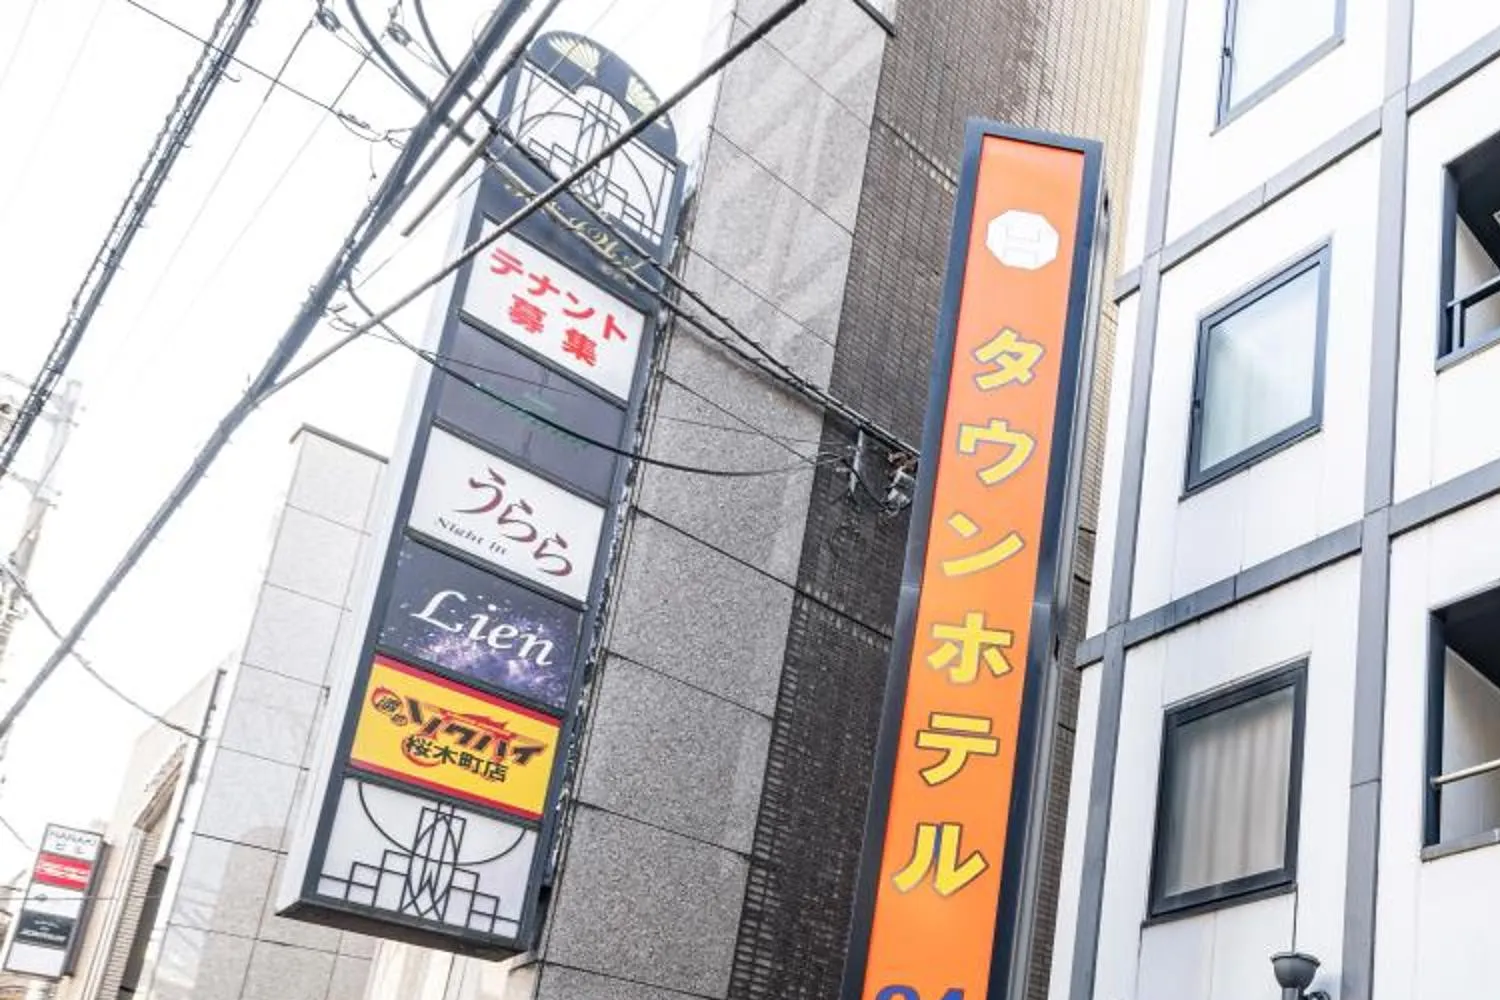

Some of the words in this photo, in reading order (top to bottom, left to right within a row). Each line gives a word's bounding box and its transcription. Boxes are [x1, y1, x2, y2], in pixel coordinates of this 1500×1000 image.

[490, 248, 627, 343] テナント
[508, 296, 597, 367] 募集
[453, 467, 573, 577] うらら
[409, 589, 554, 666] Lien
[892, 325, 1046, 897] タウンホテル
[405, 735, 509, 784] 桜木町店
